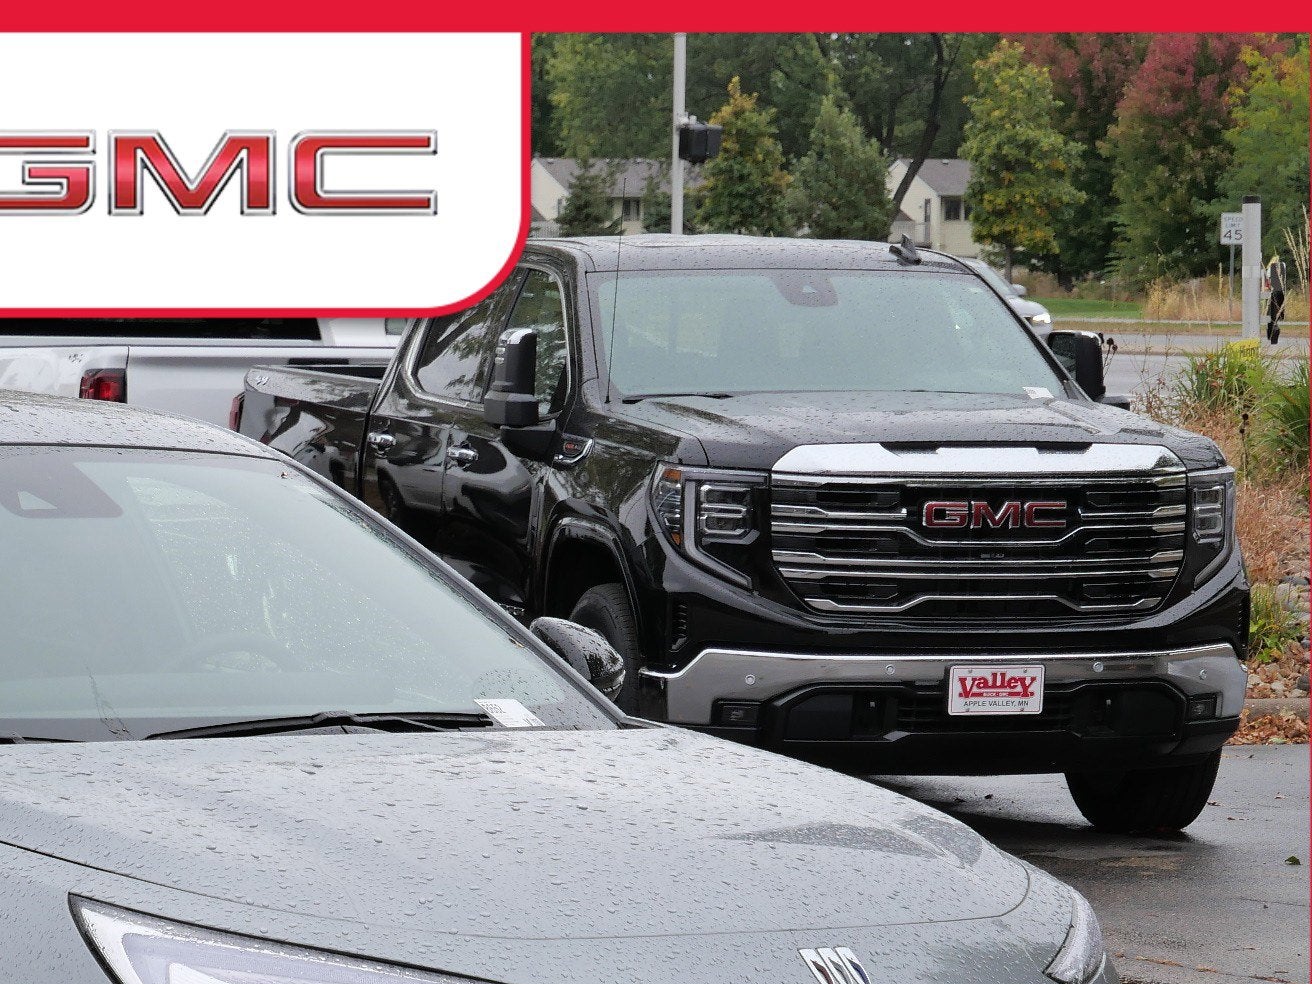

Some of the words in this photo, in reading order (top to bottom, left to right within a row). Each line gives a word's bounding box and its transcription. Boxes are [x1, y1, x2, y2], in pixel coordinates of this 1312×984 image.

[1223, 229, 1243, 241] 45
[922, 500, 1068, 529] GMC
[958, 672, 1037, 699] Valley
[988, 700, 1017, 708] VALLEY,
